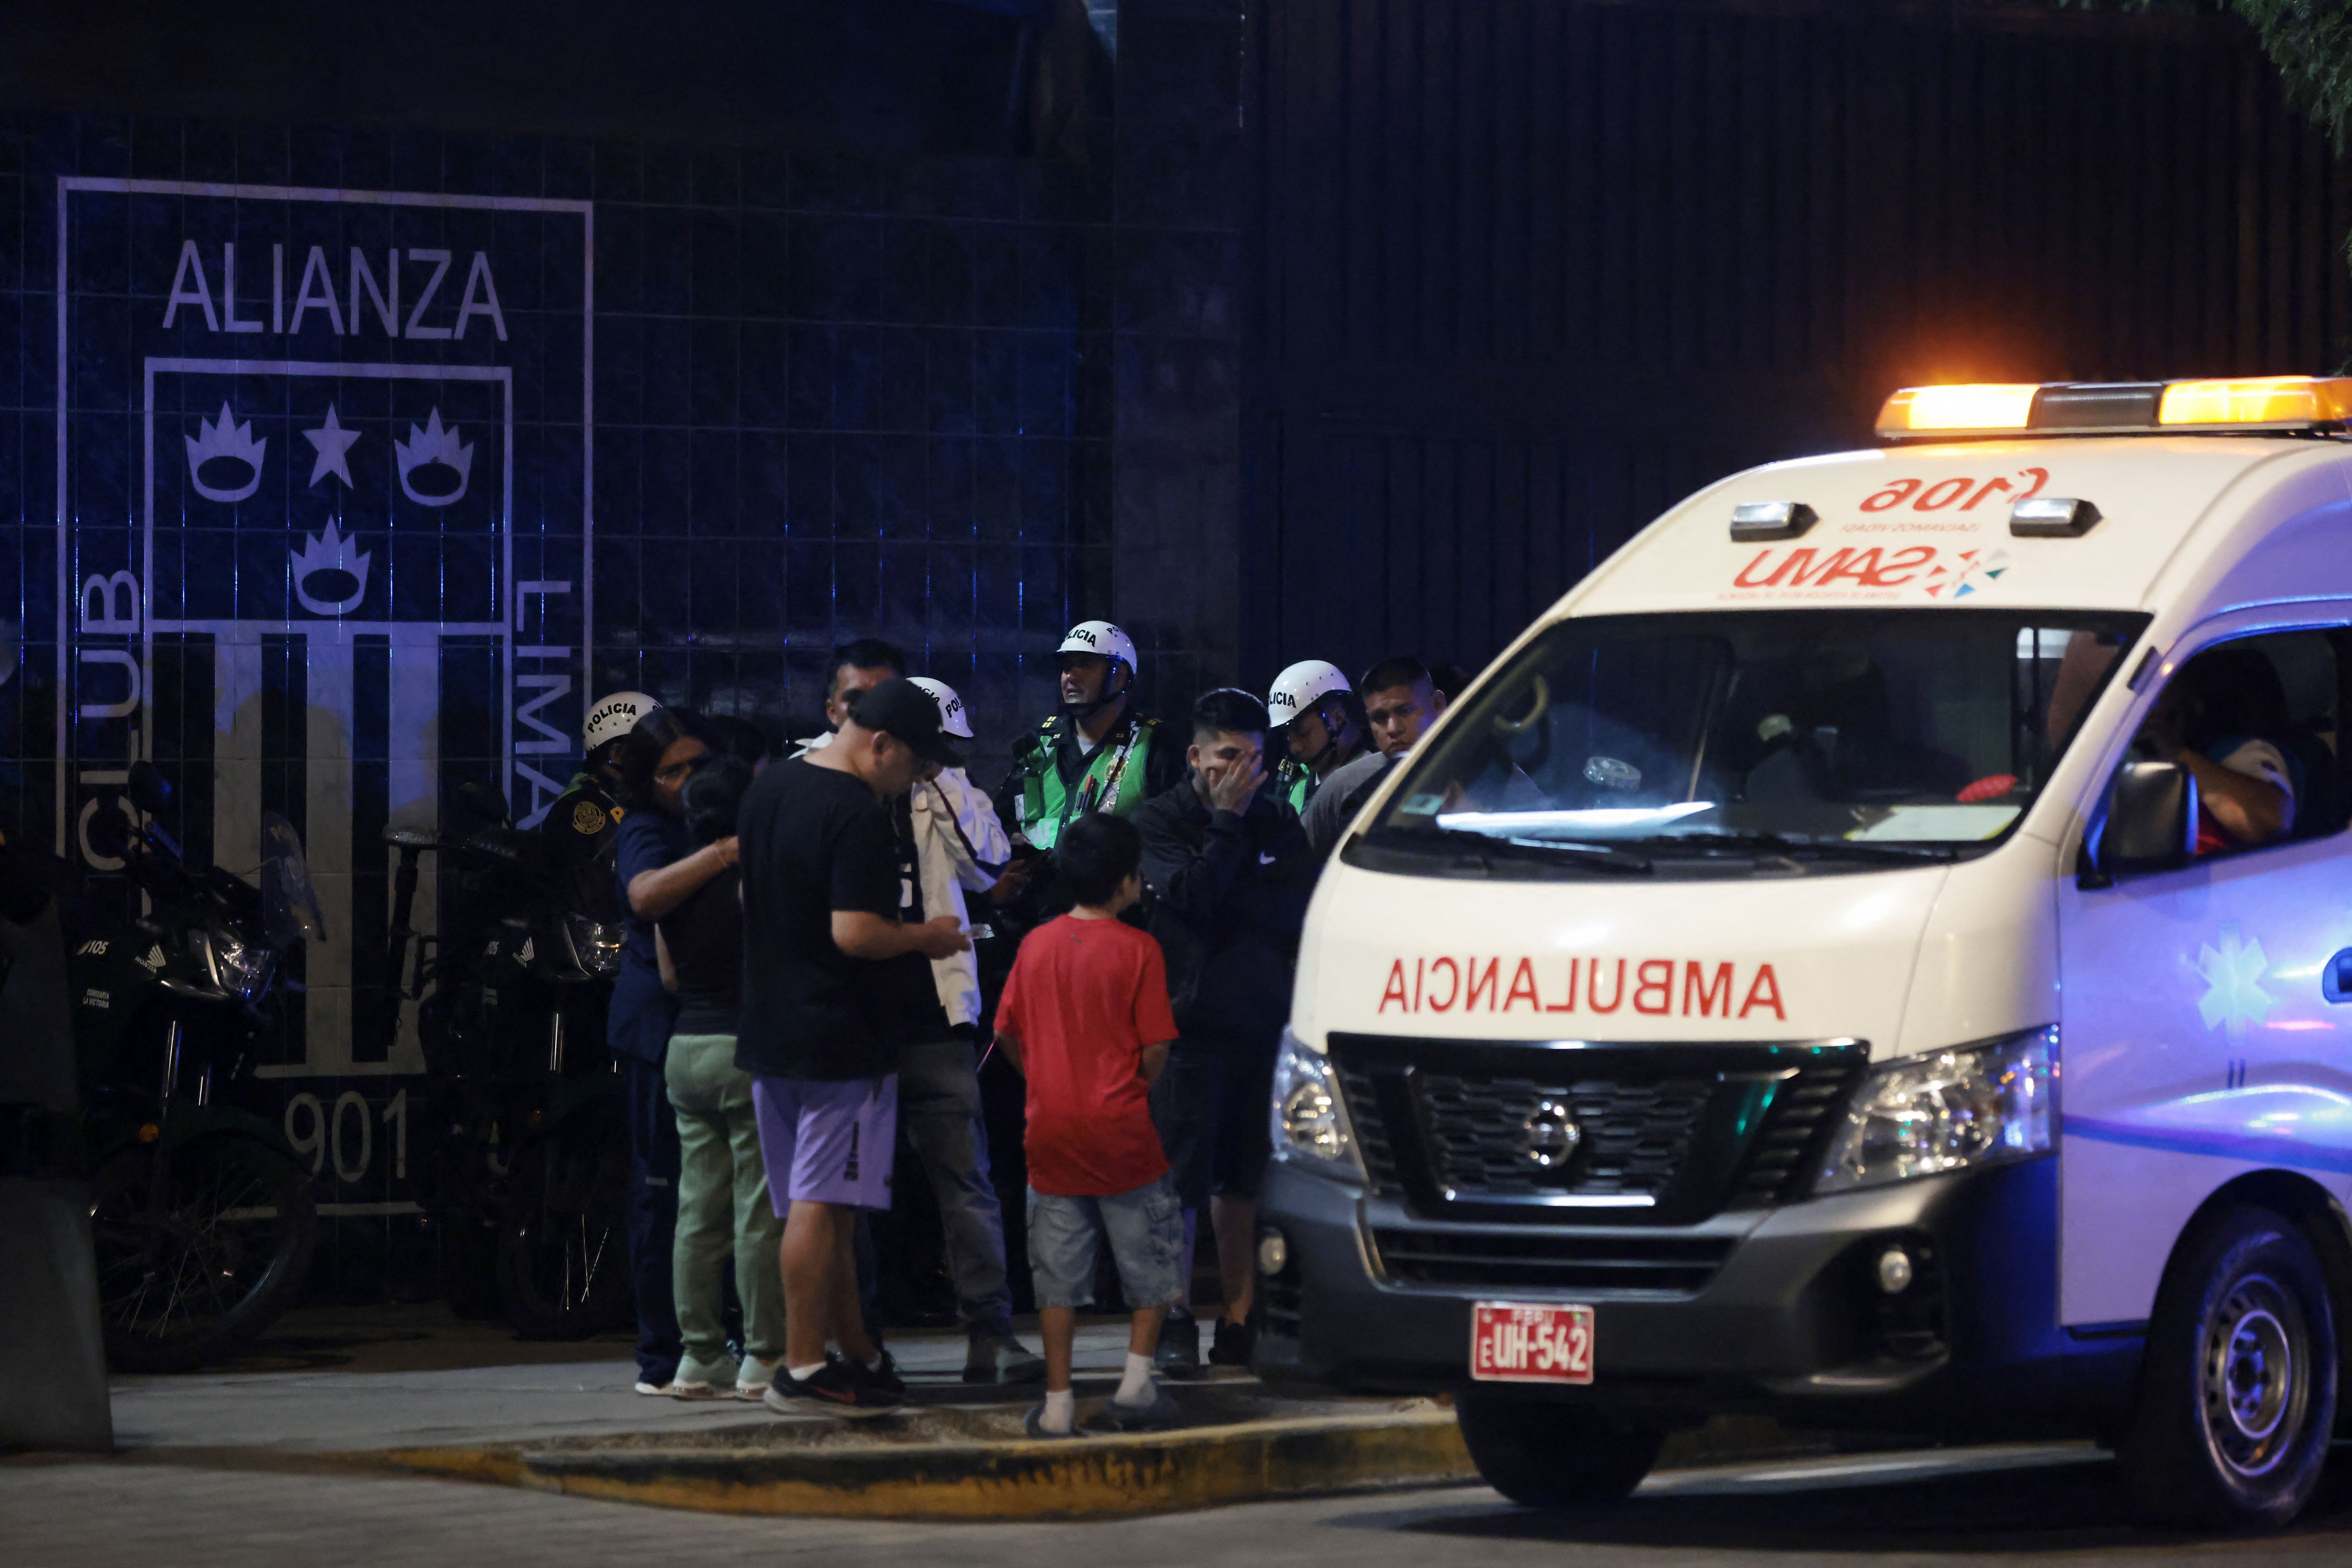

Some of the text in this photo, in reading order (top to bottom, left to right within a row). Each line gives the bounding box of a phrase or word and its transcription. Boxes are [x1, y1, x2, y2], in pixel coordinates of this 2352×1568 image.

[162, 240, 508, 341] ALIANZA
[1065, 629, 1096, 647] LICIA
[1106, 626, 1123, 635] PO
[516, 581, 571, 831] LIMA
[945, 696, 963, 719] POL
[1269, 692, 1297, 708] LICIA
[78, 570, 141, 871] CLUB
[588, 699, 636, 733] POLICIA
[87, 940, 109, 955] 105
[135, 956, 157, 973] HONDA
[285, 1088, 406, 1183] 901
